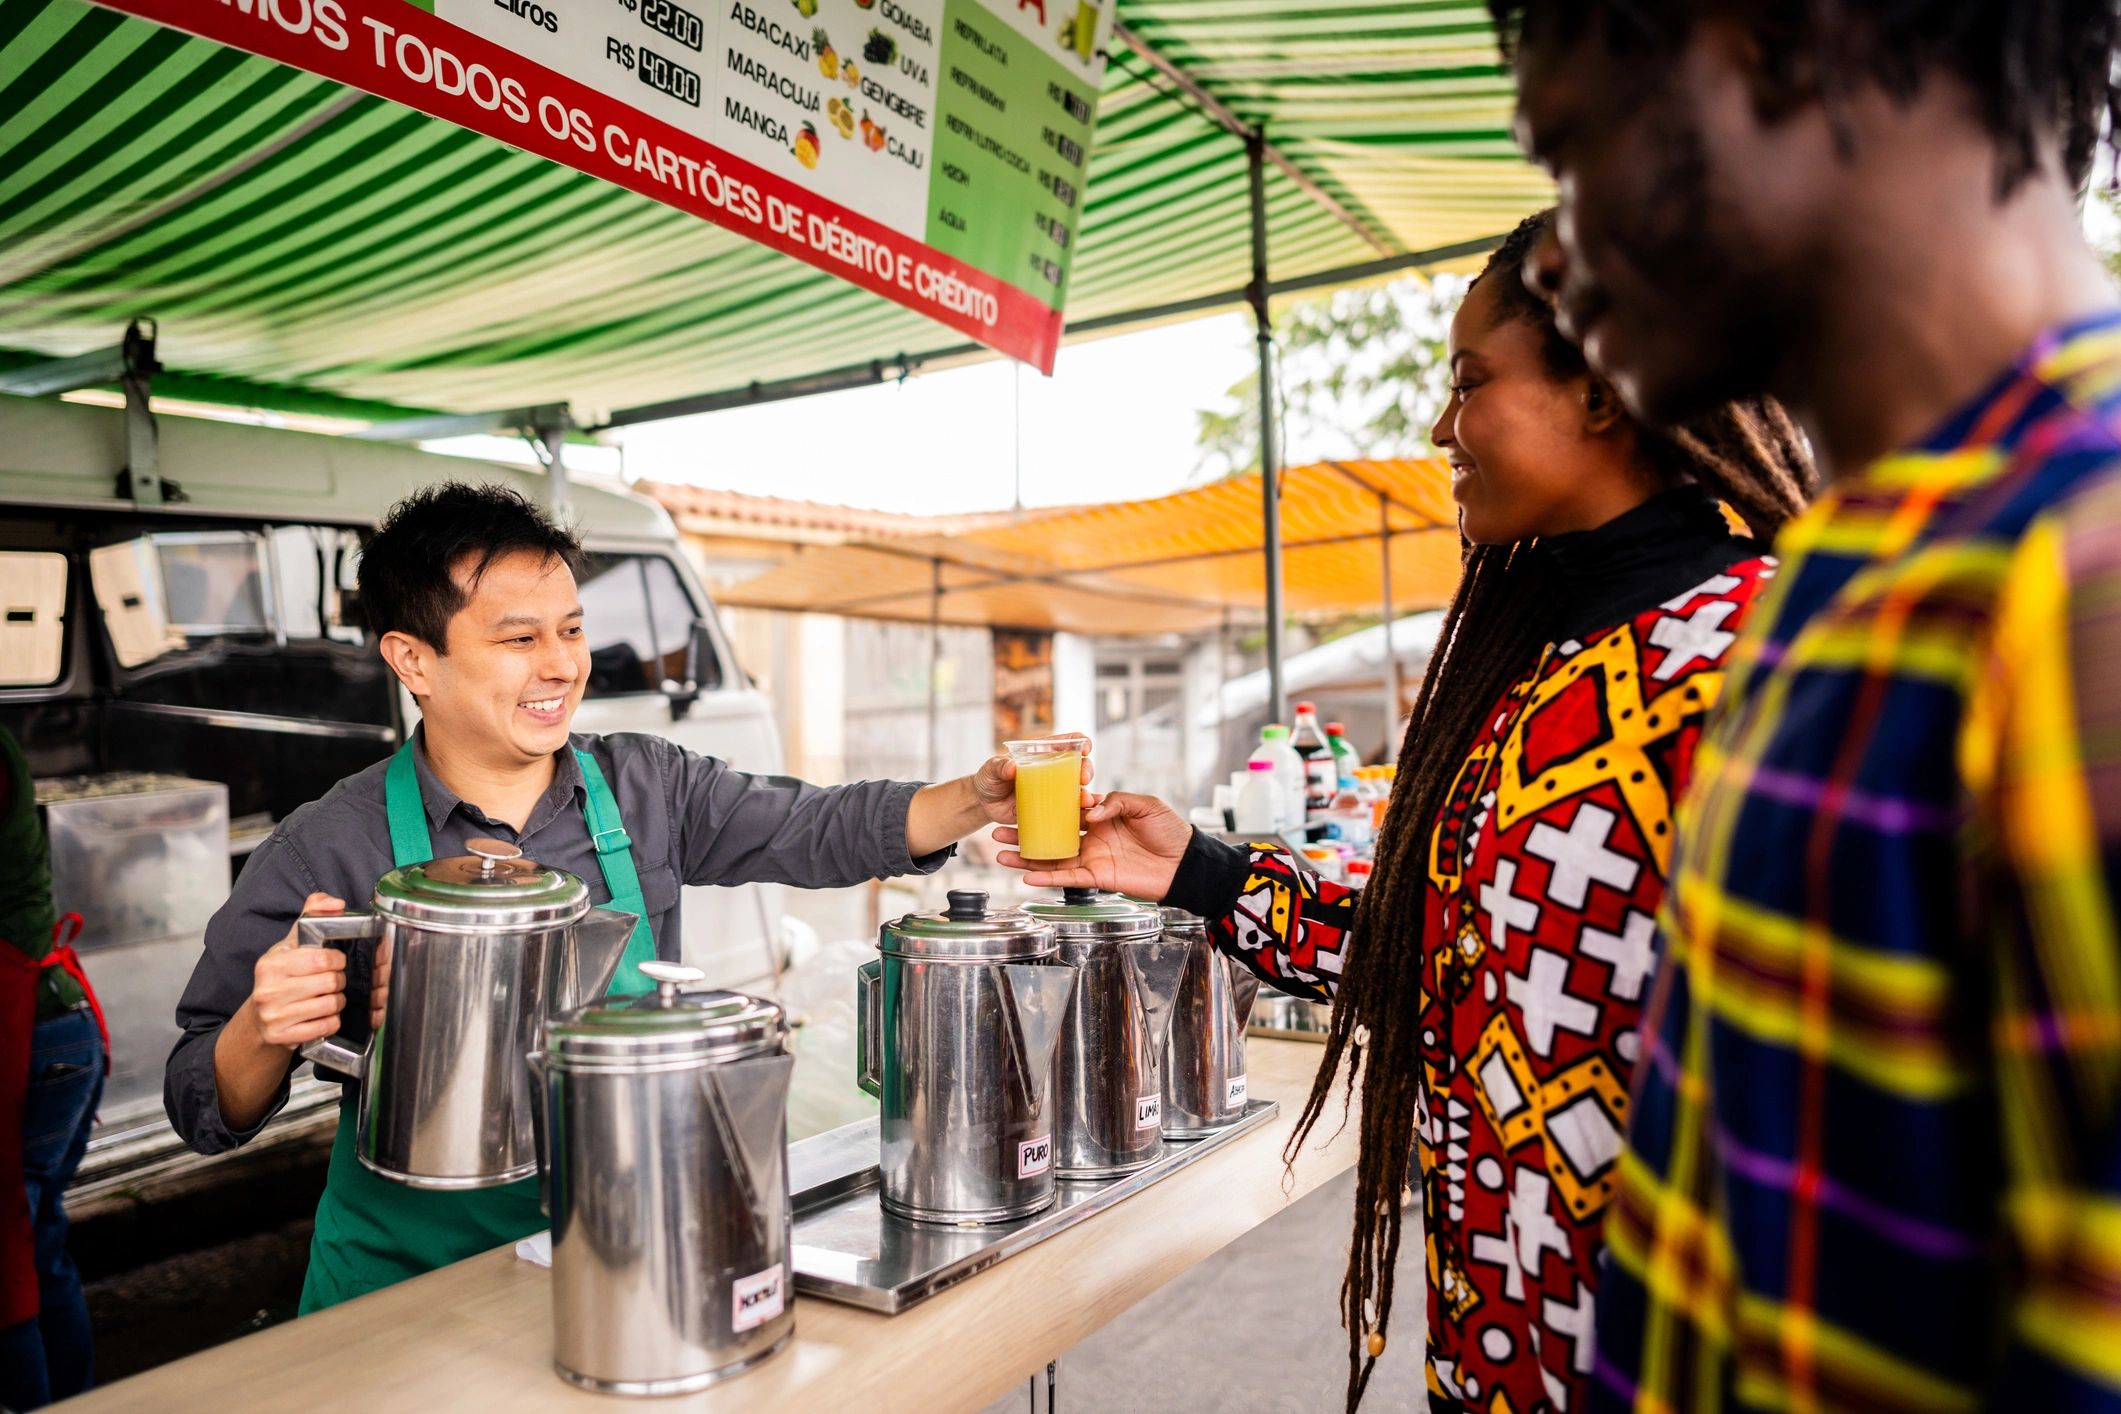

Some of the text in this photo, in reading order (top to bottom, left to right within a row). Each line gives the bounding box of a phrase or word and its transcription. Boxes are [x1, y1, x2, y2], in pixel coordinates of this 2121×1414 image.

[730, 1, 810, 62] ABACAXI
[880, 0, 932, 47] GOIABA
[606, 36, 700, 106] R$ 40.00
[727, 47, 820, 113] MARACUJÁ
[900, 56, 929, 89] UVA
[725, 96, 790, 147] MANGA
[362, 16, 530, 124] TODOS
[538, 96, 597, 153] OS
[603, 124, 763, 225] CARTÕES
[767, 195, 806, 244] DE
[808, 216, 895, 281] DÉBITO
[897, 253, 913, 290] E
[915, 262, 998, 327] CRÉDITO
[887, 135, 925, 170] CAJU
[1023, 1143, 1049, 1167] PURO
